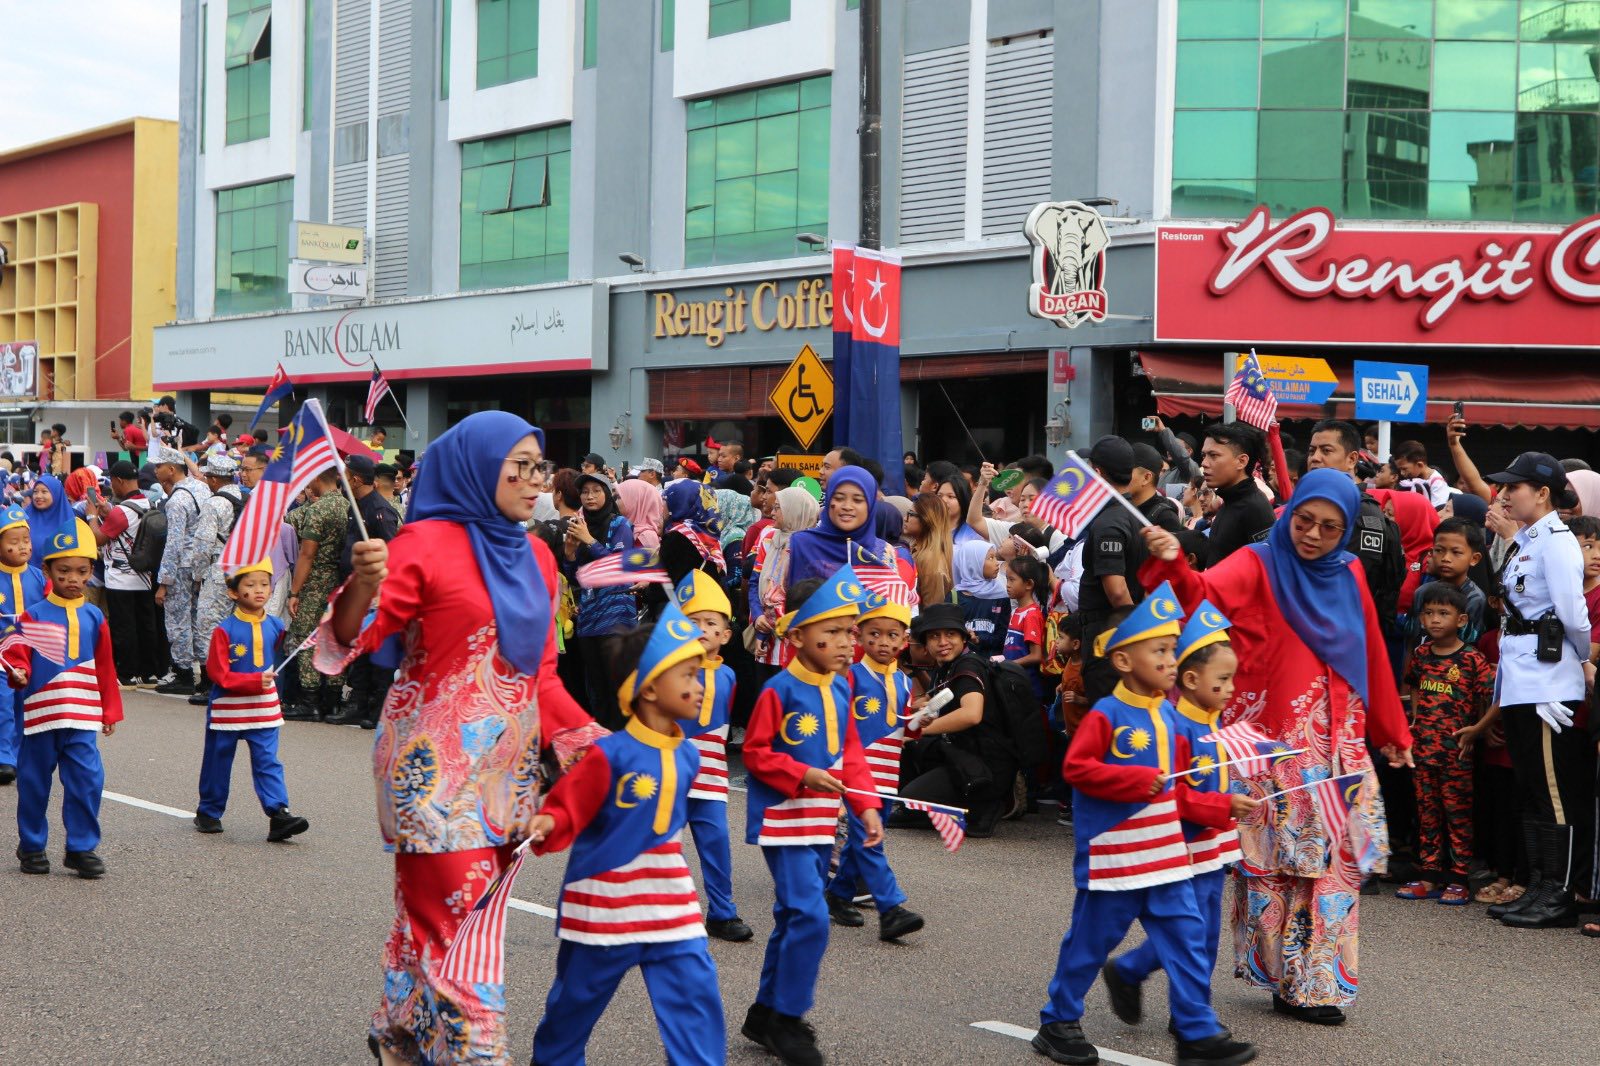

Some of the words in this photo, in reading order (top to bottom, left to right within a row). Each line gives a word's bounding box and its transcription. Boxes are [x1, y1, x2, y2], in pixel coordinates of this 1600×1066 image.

[1161, 231, 1204, 241] Restoran
[1212, 208, 1535, 326] Rengit
[1044, 294, 1100, 312] DAGAN
[652, 287, 748, 347] Rengit
[283, 325, 335, 357] BANK
[344, 320, 402, 353] ISLAM
[1269, 381, 1311, 393] SULAIMAN
[1367, 382, 1411, 401] SEHALA
[1100, 541, 1123, 552] CID
[1363, 535, 1381, 548] CID
